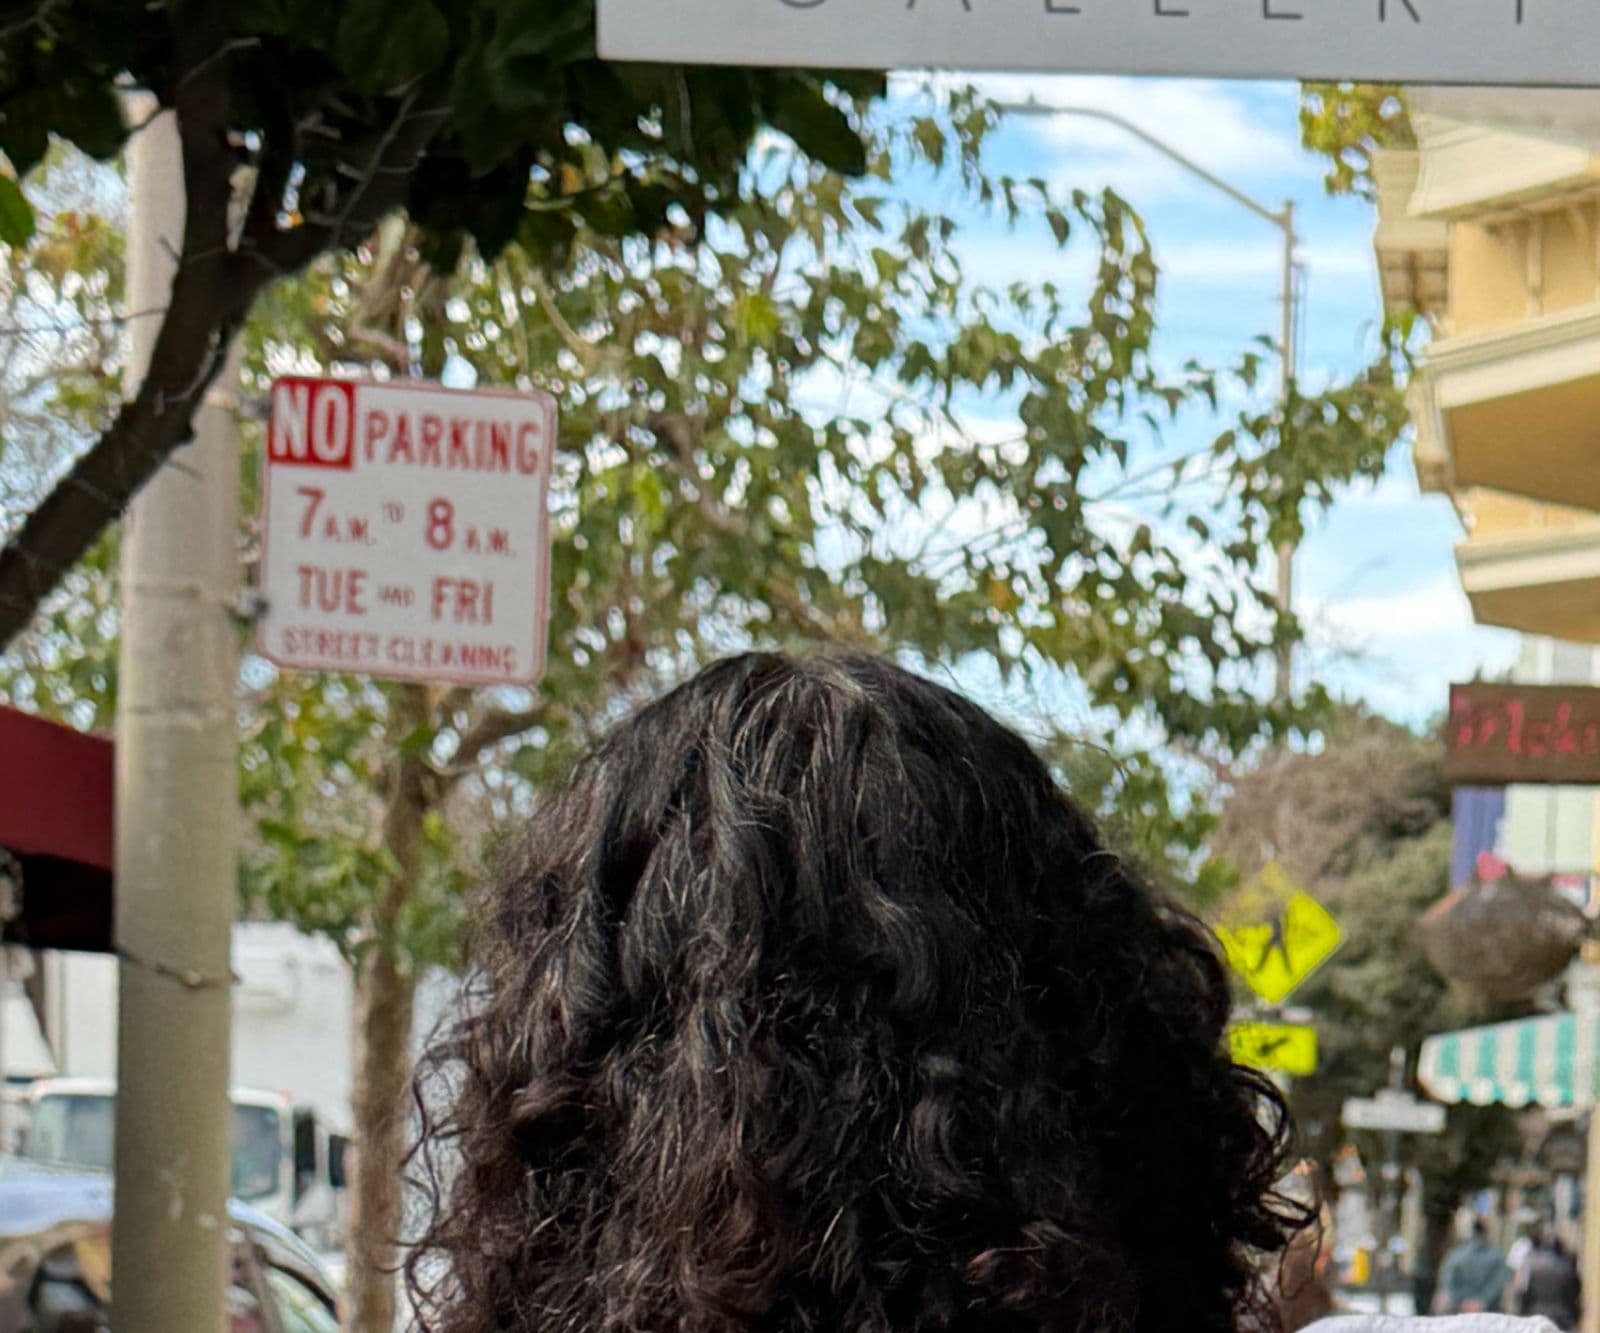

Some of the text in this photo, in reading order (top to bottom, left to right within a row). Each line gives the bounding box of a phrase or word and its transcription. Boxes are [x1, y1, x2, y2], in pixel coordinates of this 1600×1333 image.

[271, 381, 540, 475] NO PARKING
[296, 485, 325, 538] 7
[424, 497, 456, 553] 8
[296, 564, 368, 615] TUE
[430, 575, 494, 625] FRI
[282, 627, 517, 674] STREET CLEANING
